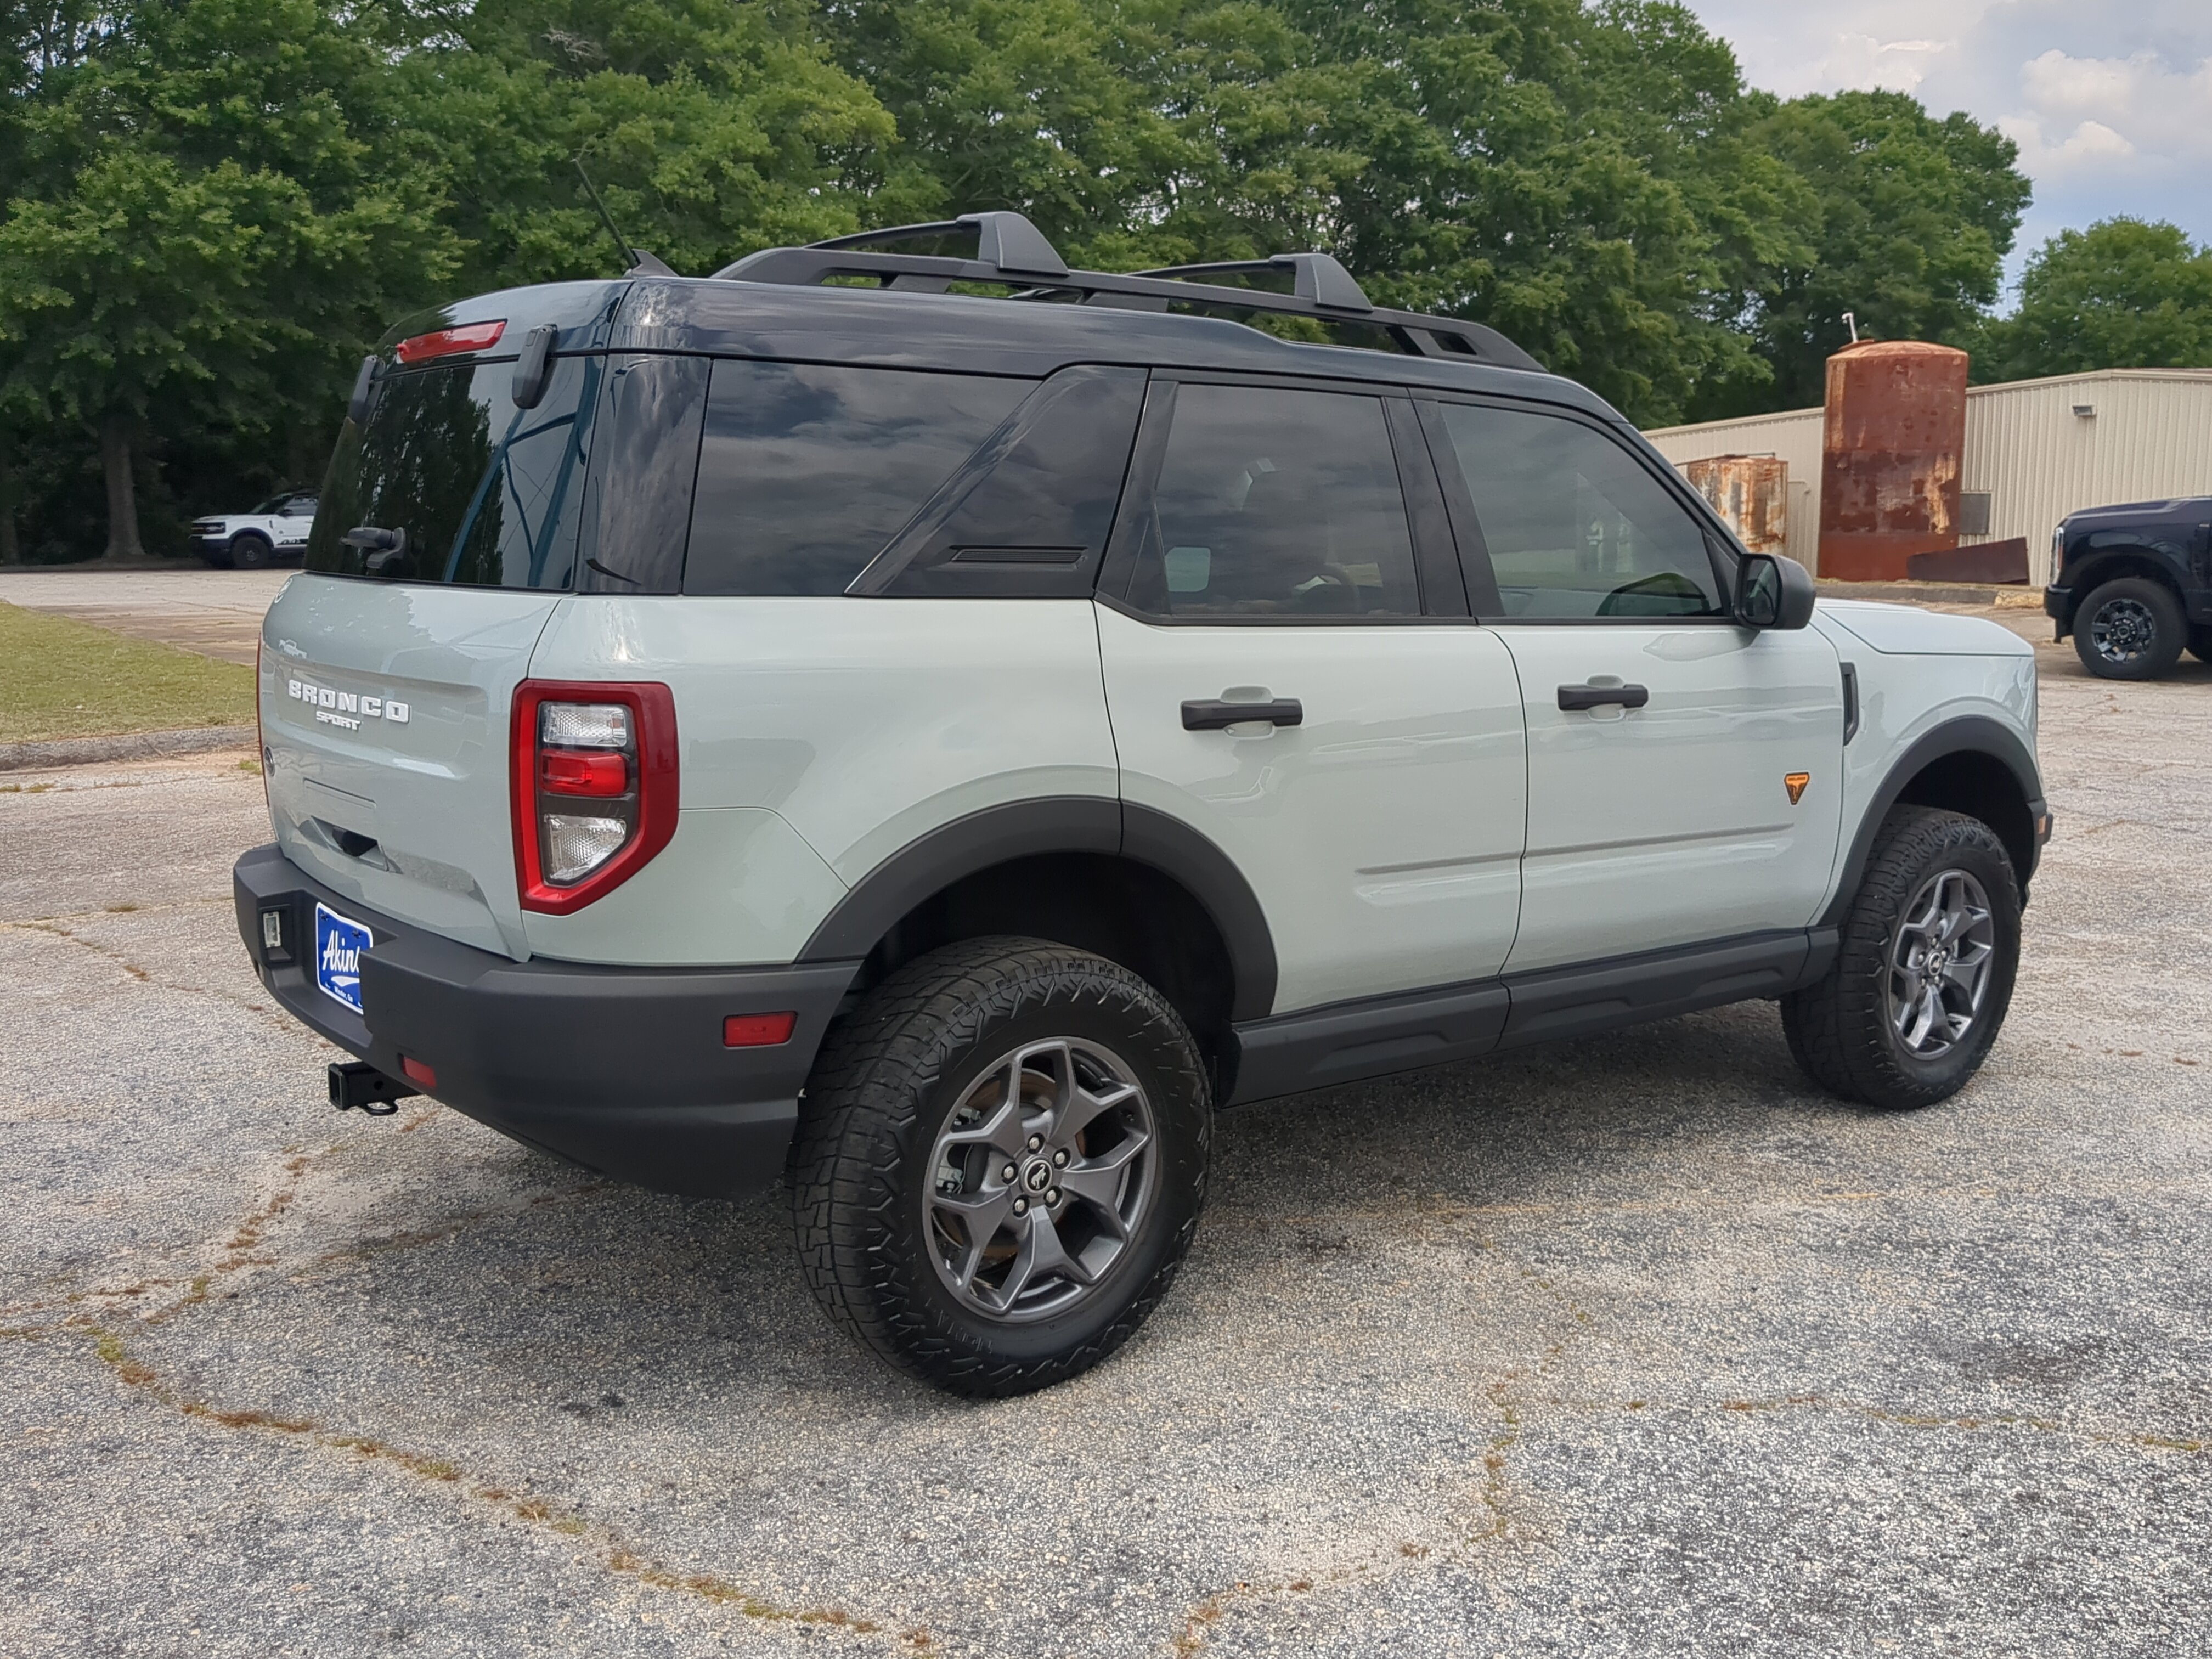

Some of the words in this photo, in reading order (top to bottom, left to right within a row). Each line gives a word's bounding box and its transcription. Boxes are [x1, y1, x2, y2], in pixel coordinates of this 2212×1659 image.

[289, 679, 409, 723] BRONCO
[316, 710, 361, 730] SPORT
[322, 929, 360, 973] Akin
